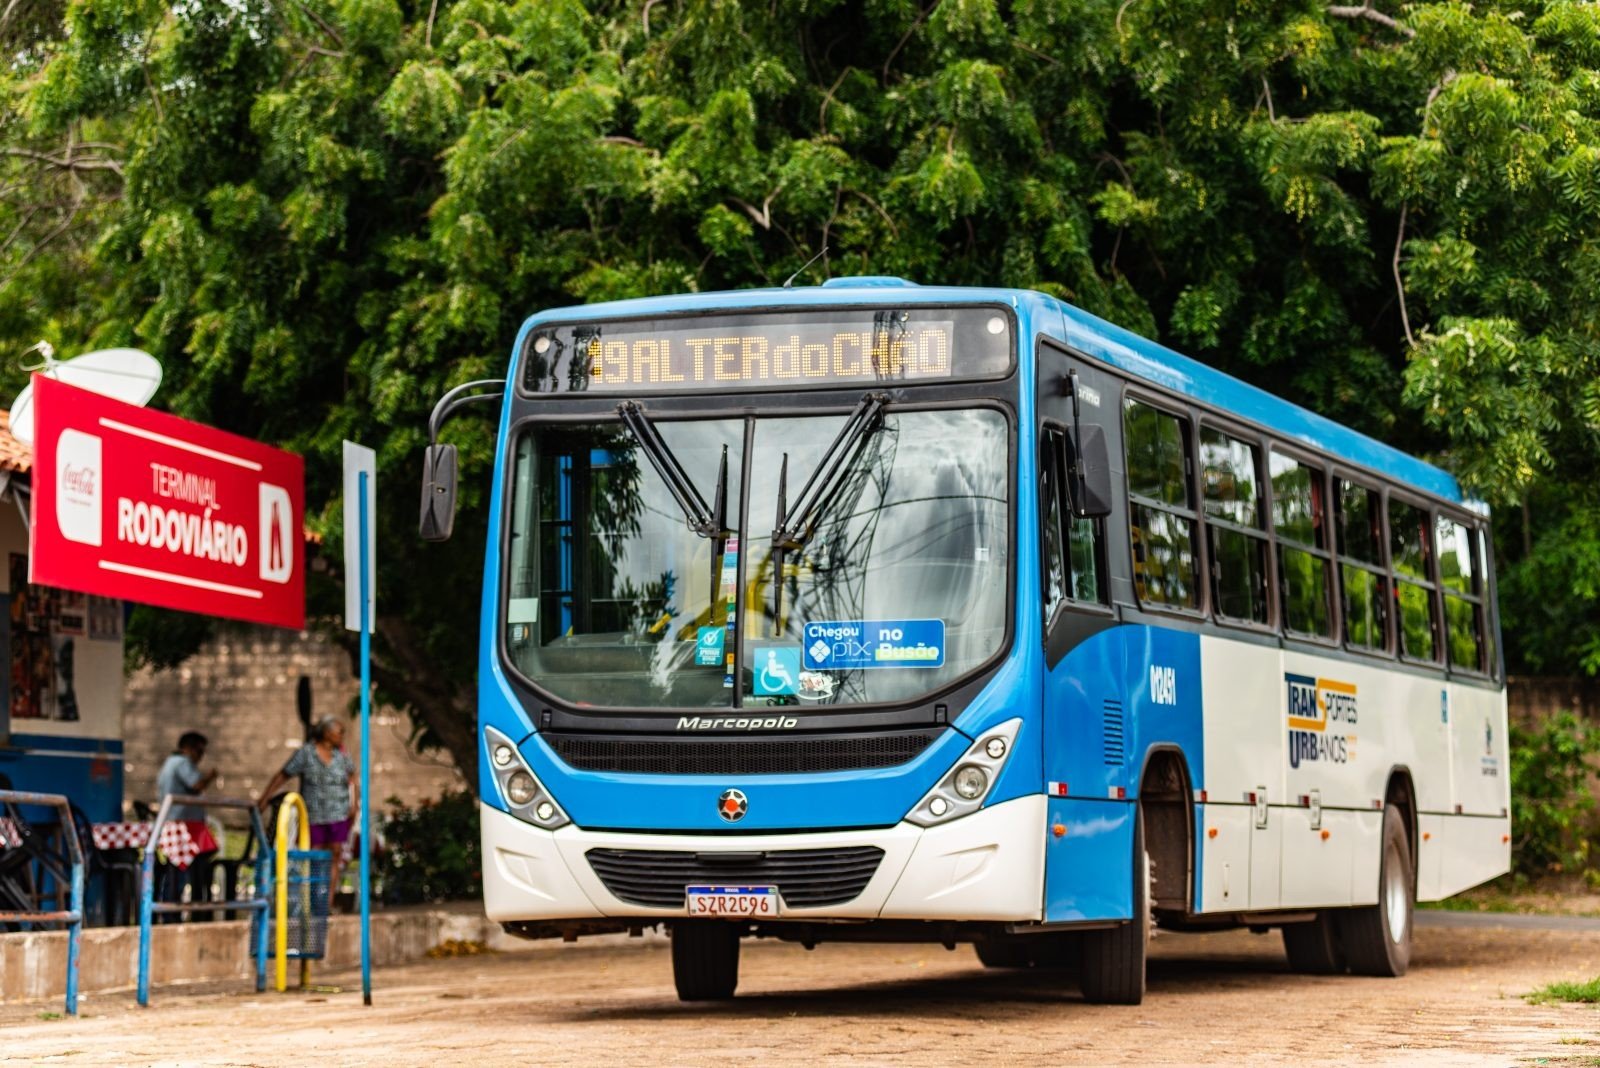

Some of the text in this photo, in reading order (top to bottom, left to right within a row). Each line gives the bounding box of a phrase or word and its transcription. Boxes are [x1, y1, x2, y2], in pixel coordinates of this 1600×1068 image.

[632, 336, 769, 383] ALTER
[150, 462, 221, 511] TERMINAL
[117, 496, 248, 568] RODOVIÁRIO
[808, 625, 860, 641] Chegou
[879, 628, 904, 641] no
[832, 639, 872, 662] pix
[878, 642, 940, 660] Busão
[676, 715, 799, 731] Marcopolo
[1288, 729, 1348, 769] URBANOS
[697, 896, 769, 914] SZR2C96
